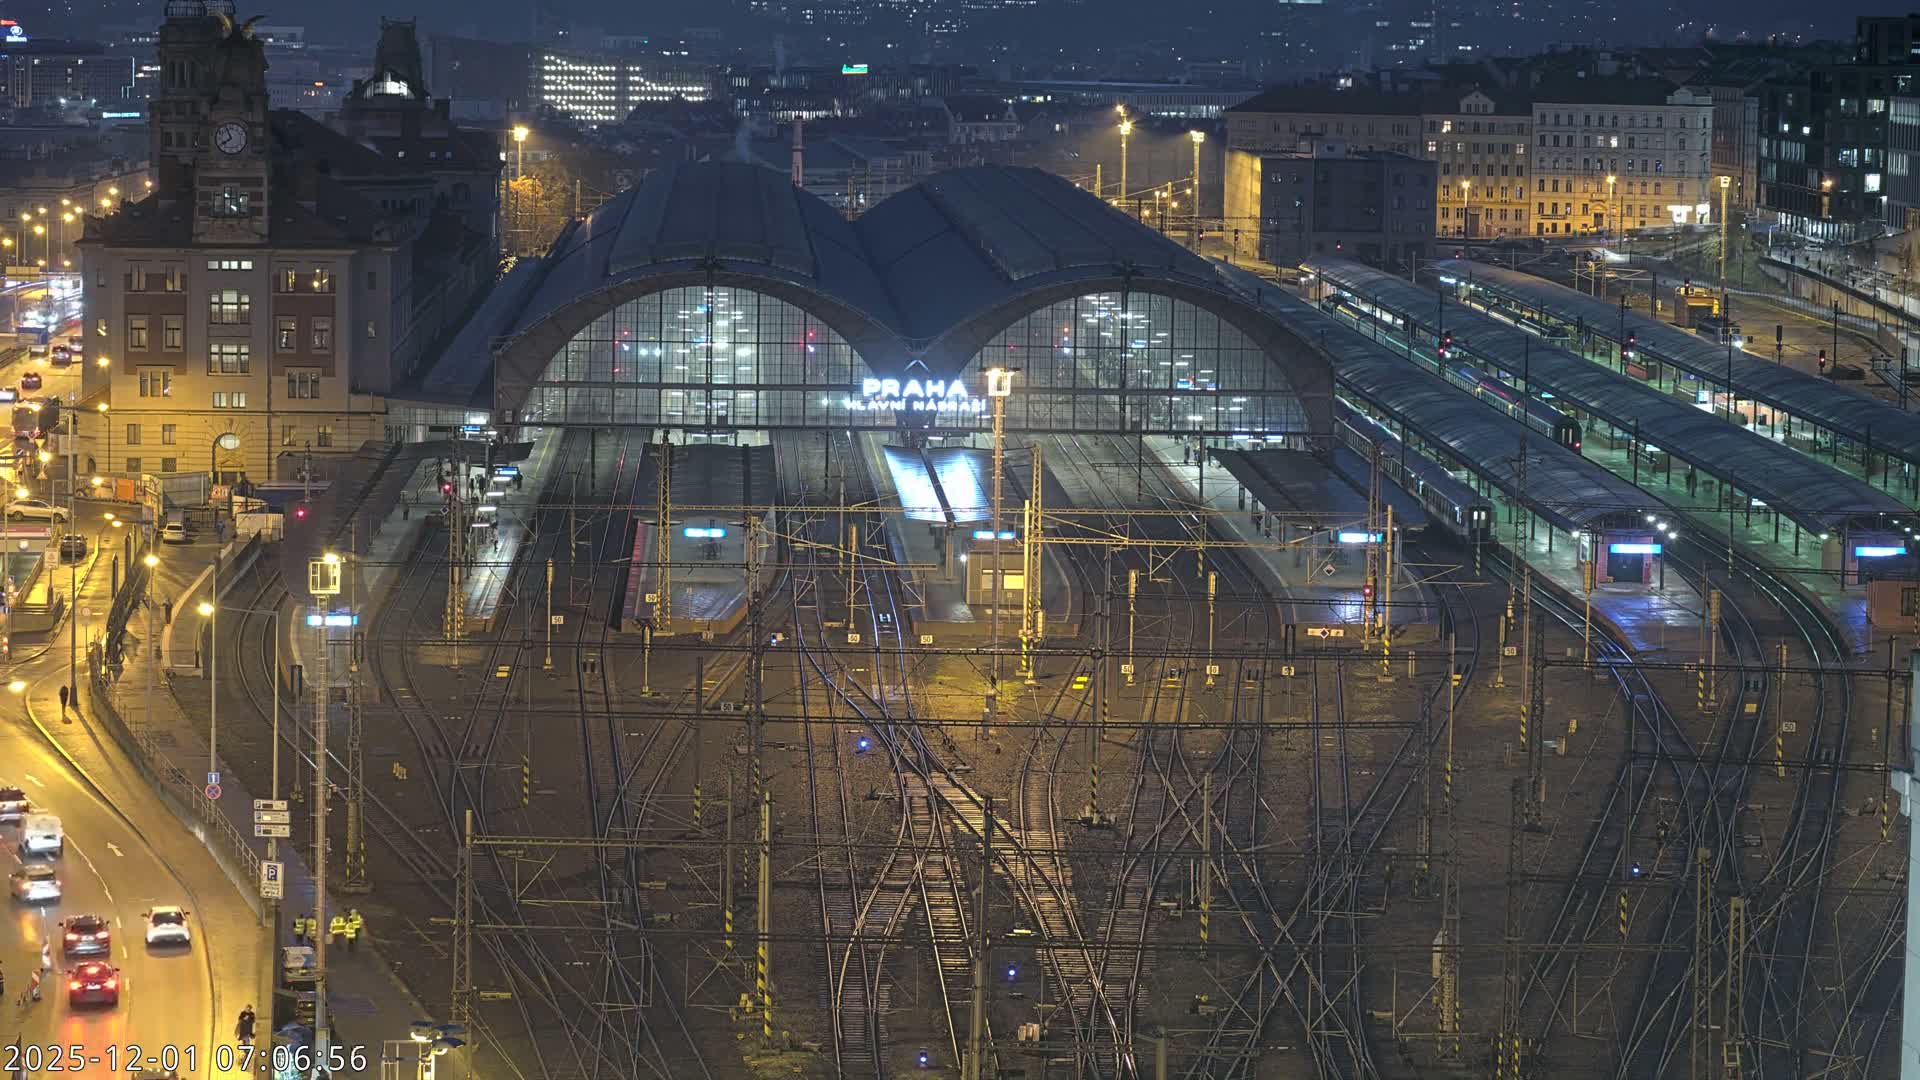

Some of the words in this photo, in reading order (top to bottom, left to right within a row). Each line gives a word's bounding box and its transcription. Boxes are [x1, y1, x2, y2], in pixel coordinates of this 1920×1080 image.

[863, 378, 968, 397] PRAHA
[844, 398, 906, 411] HLAVNÍ
[1784, 723, 1794, 731] 50
